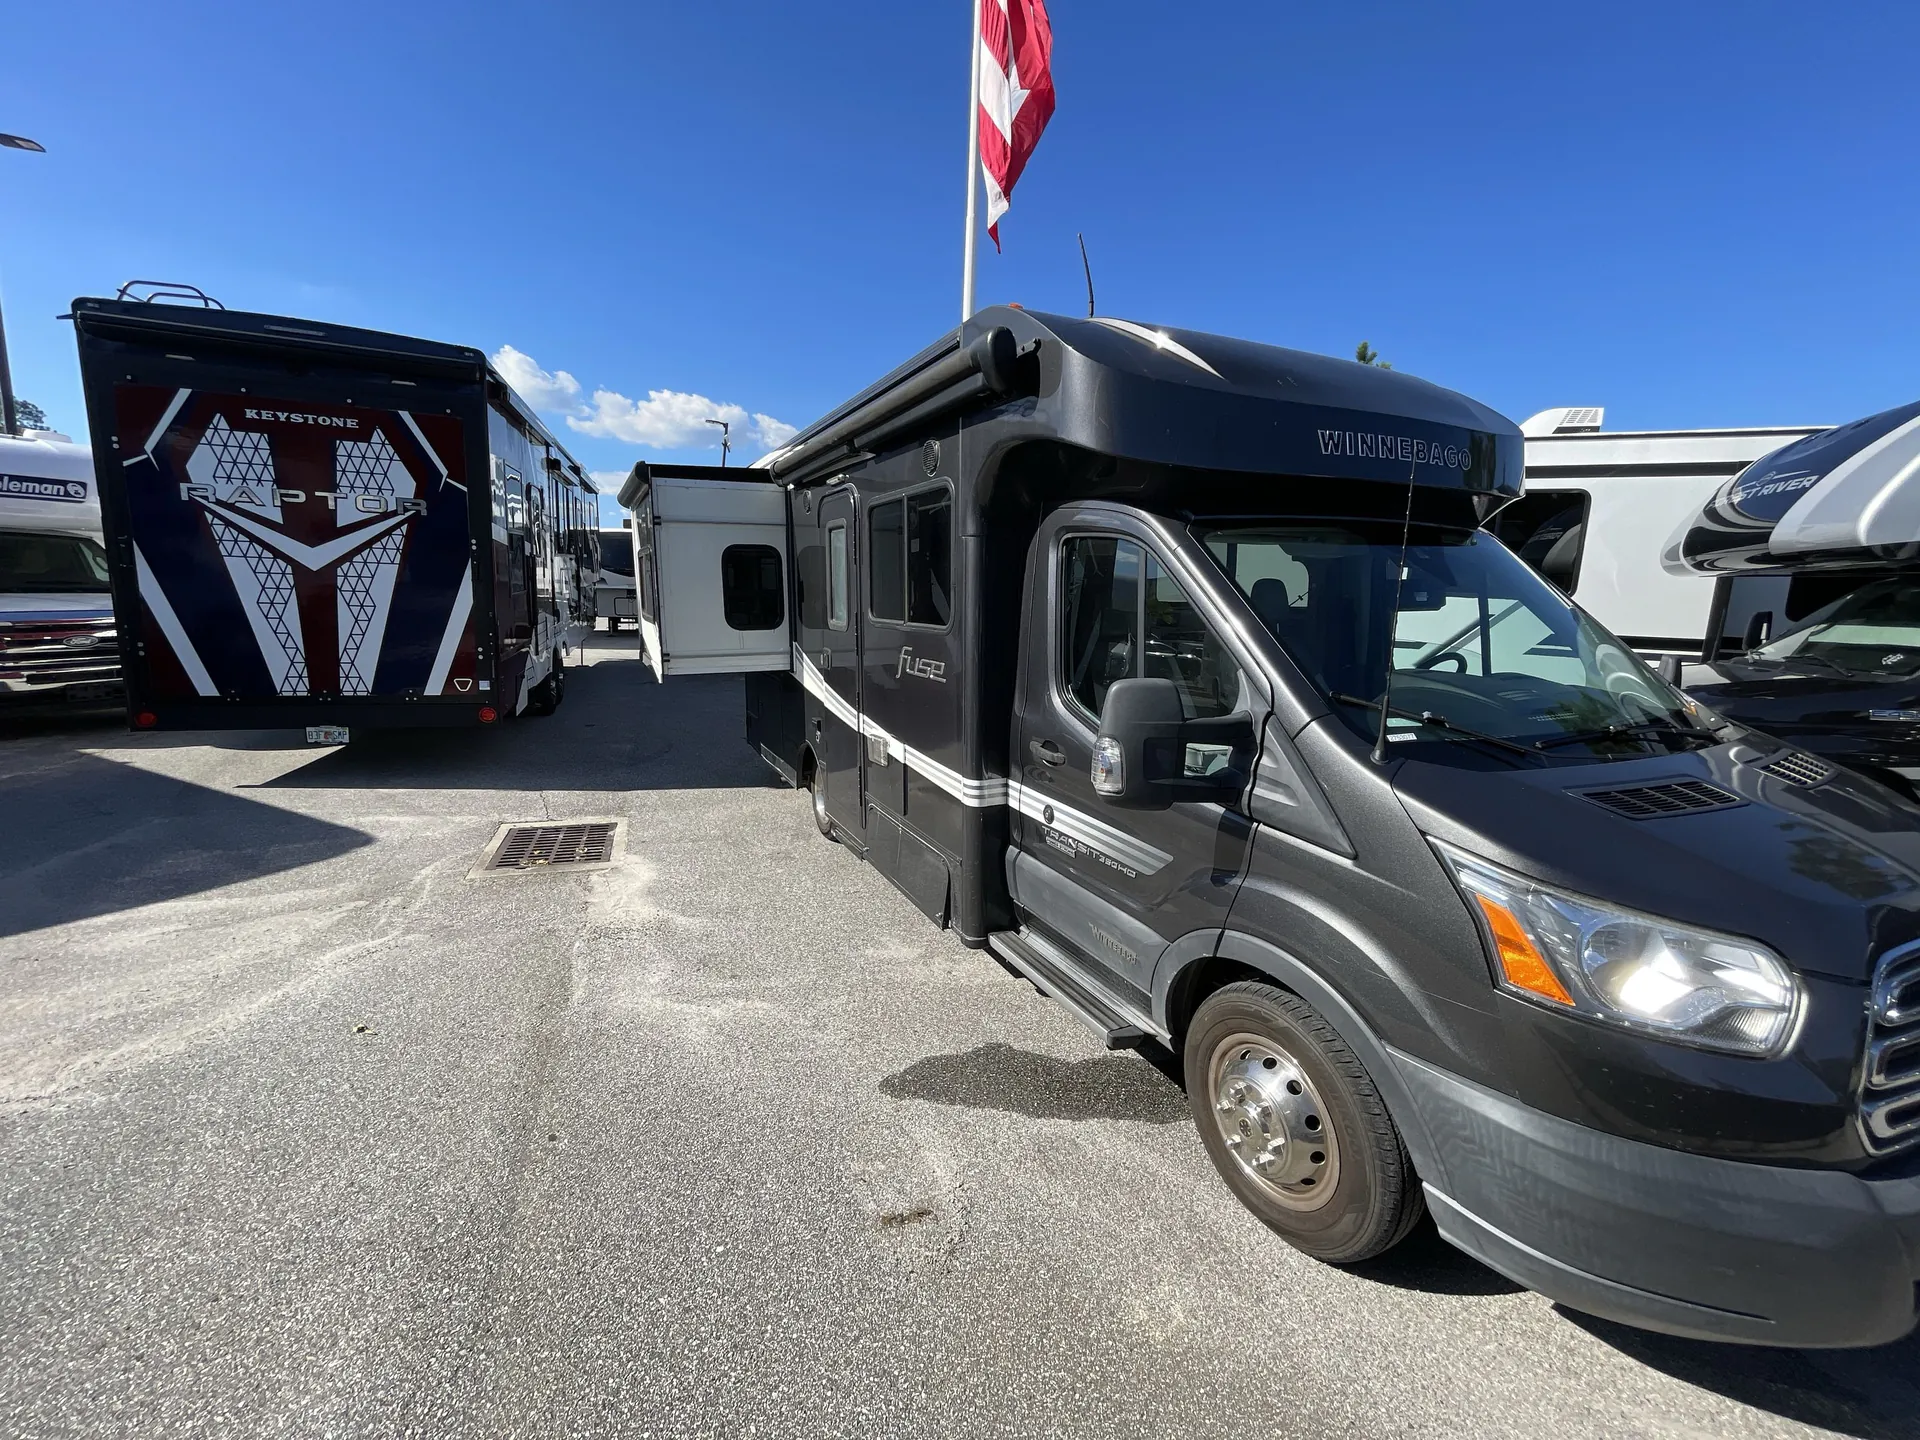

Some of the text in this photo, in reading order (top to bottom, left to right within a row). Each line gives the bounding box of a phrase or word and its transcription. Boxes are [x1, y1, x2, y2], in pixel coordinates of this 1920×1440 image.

[244, 408, 359, 429] KEYSTONE
[1317, 429, 1472, 471] WINNEBAGO
[0, 475, 65, 496] leman
[179, 482, 428, 516] RAPTOR
[1757, 475, 1820, 497] RIVER
[895, 646, 947, 683] fuse
[1041, 825, 1100, 858] TRANSIT
